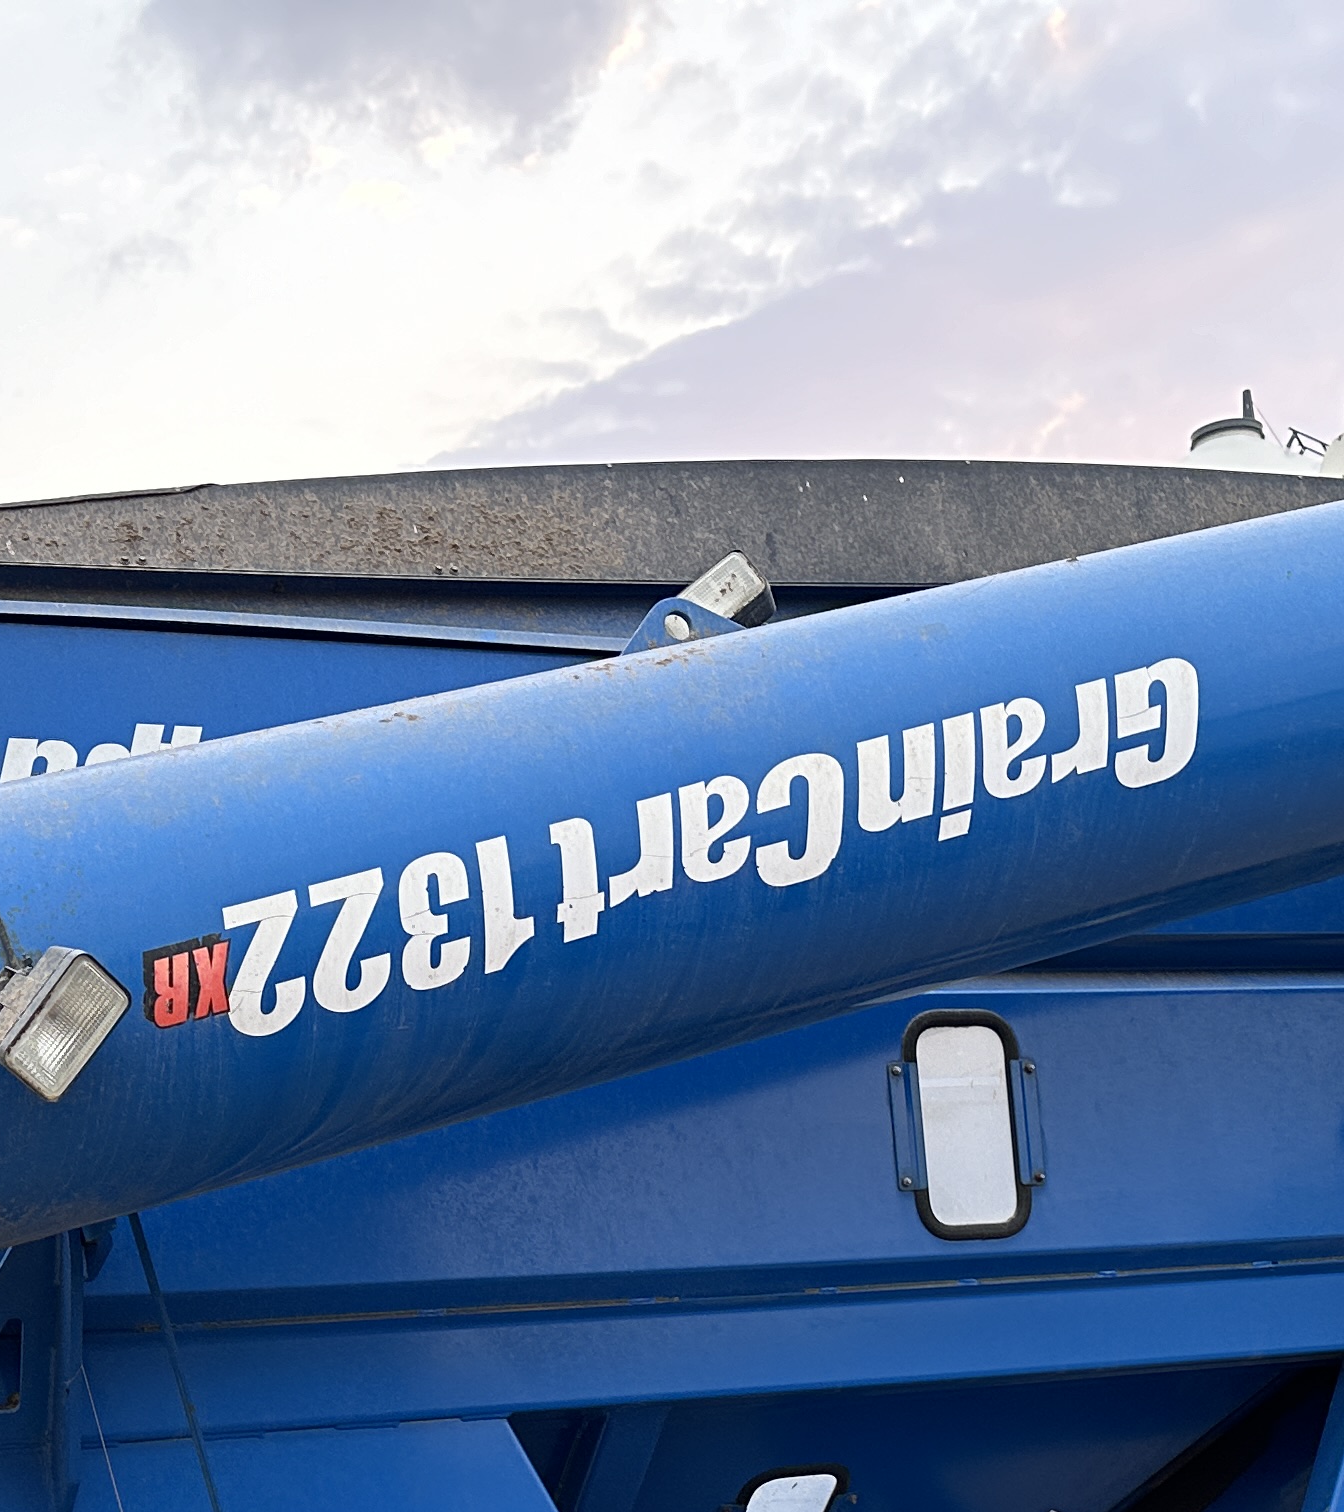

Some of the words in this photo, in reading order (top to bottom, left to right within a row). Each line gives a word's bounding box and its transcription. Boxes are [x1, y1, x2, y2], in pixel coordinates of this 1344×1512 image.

[548, 656, 1199, 944] GrainCart
[147, 937, 232, 1029] XR
[222, 835, 535, 1037] 1322
